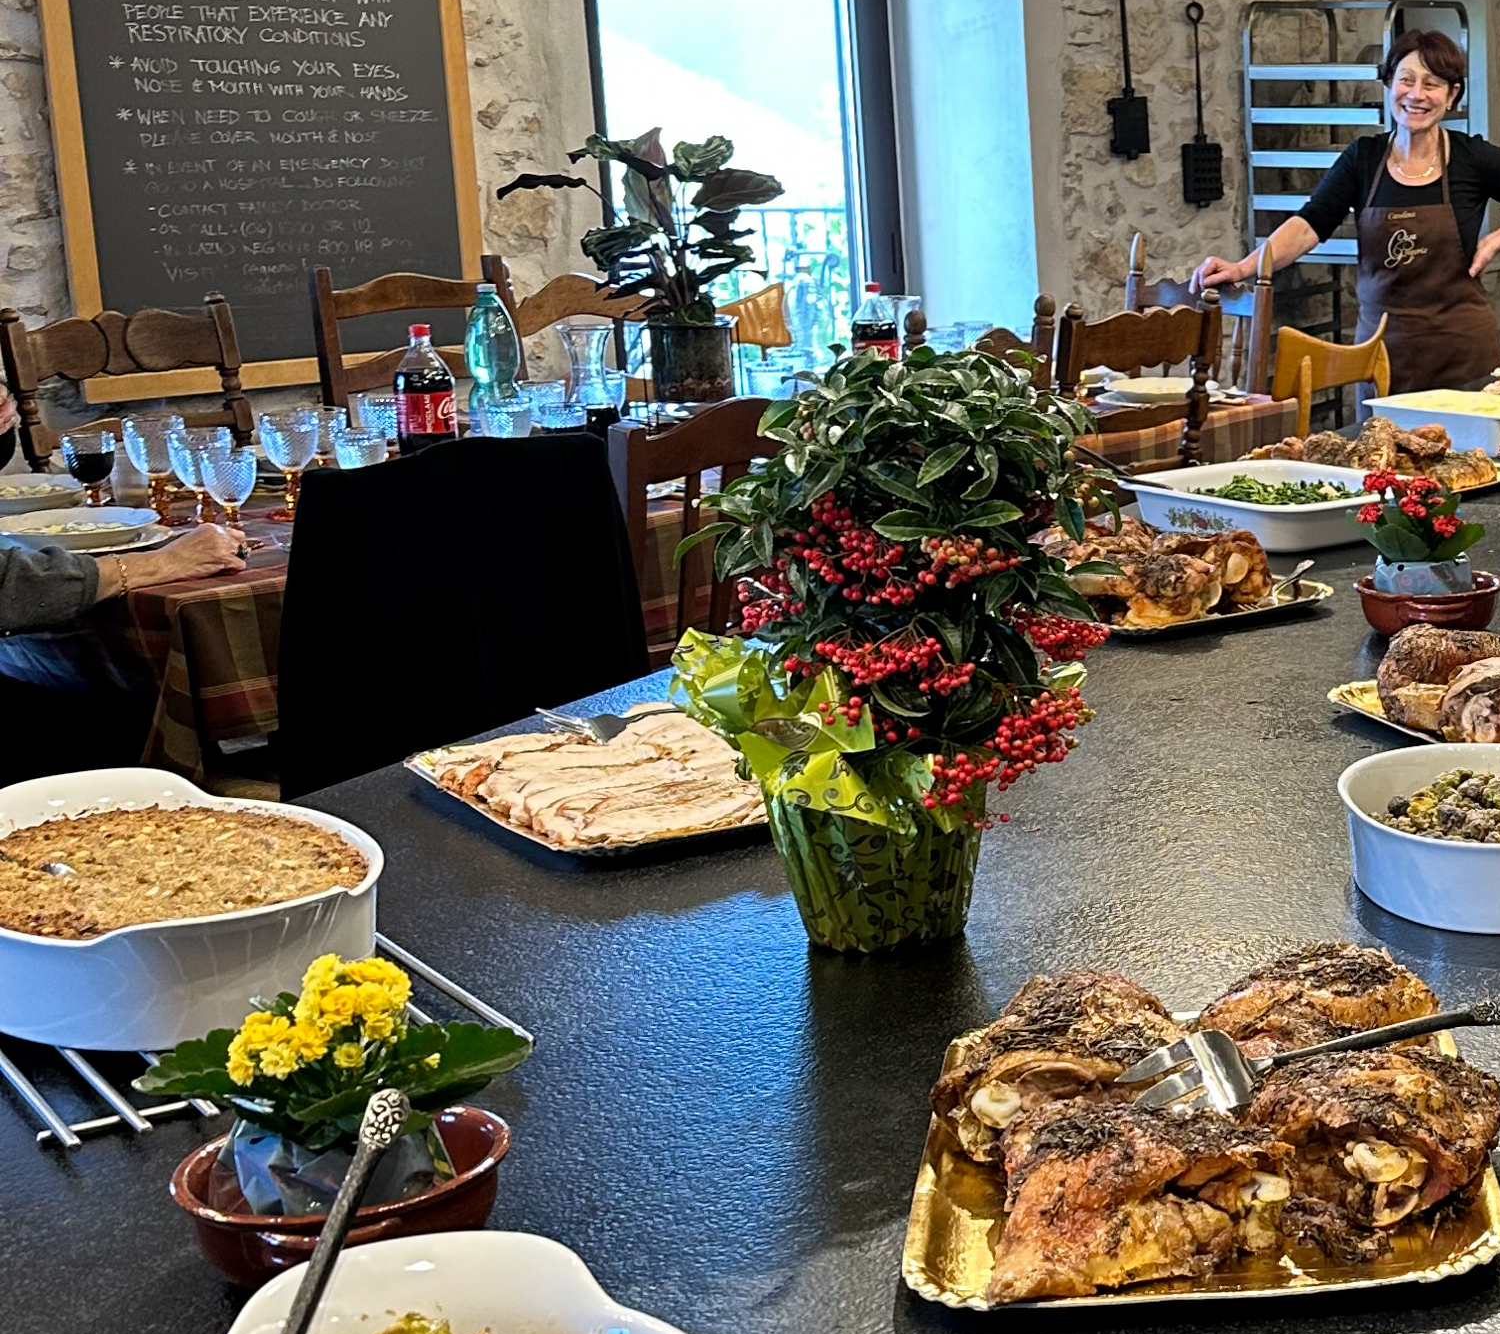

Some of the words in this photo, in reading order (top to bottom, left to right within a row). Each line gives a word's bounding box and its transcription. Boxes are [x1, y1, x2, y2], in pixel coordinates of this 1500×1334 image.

[120, 3, 185, 21] PEOPLE
[189, 5, 241, 23] THAT
[247, 5, 350, 26] EXPERIENCE
[357, 10, 394, 28] ANY
[125, 22, 249, 45] RESPIRATORY
[258, 27, 367, 48] CONDITIONS
[129, 56, 179, 75] AVOID
[188, 58, 282, 77] TOUCHING
[291, 59, 343, 78] YOUR
[133, 77, 184, 93] NOSE
[206, 79, 264, 95] MOUTH
[267, 82, 304, 97] WITH
[308, 84, 356, 99] YOUR
[359, 85, 409, 103] HANDS
[136, 108, 186, 126] WHEN
[194, 108, 241, 126] NEED
[246, 109, 272, 123] TO
[281, 108, 336, 123] COUGH
[343, 110, 365, 123] OR
[209, 130, 260, 145] COVER
[269, 130, 324, 145] MOUTH
[344, 130, 382, 144] NOSE
[226, 159, 246, 173] OF
[251, 158, 272, 173] AN
[279, 156, 371, 172] EMERGENCY
